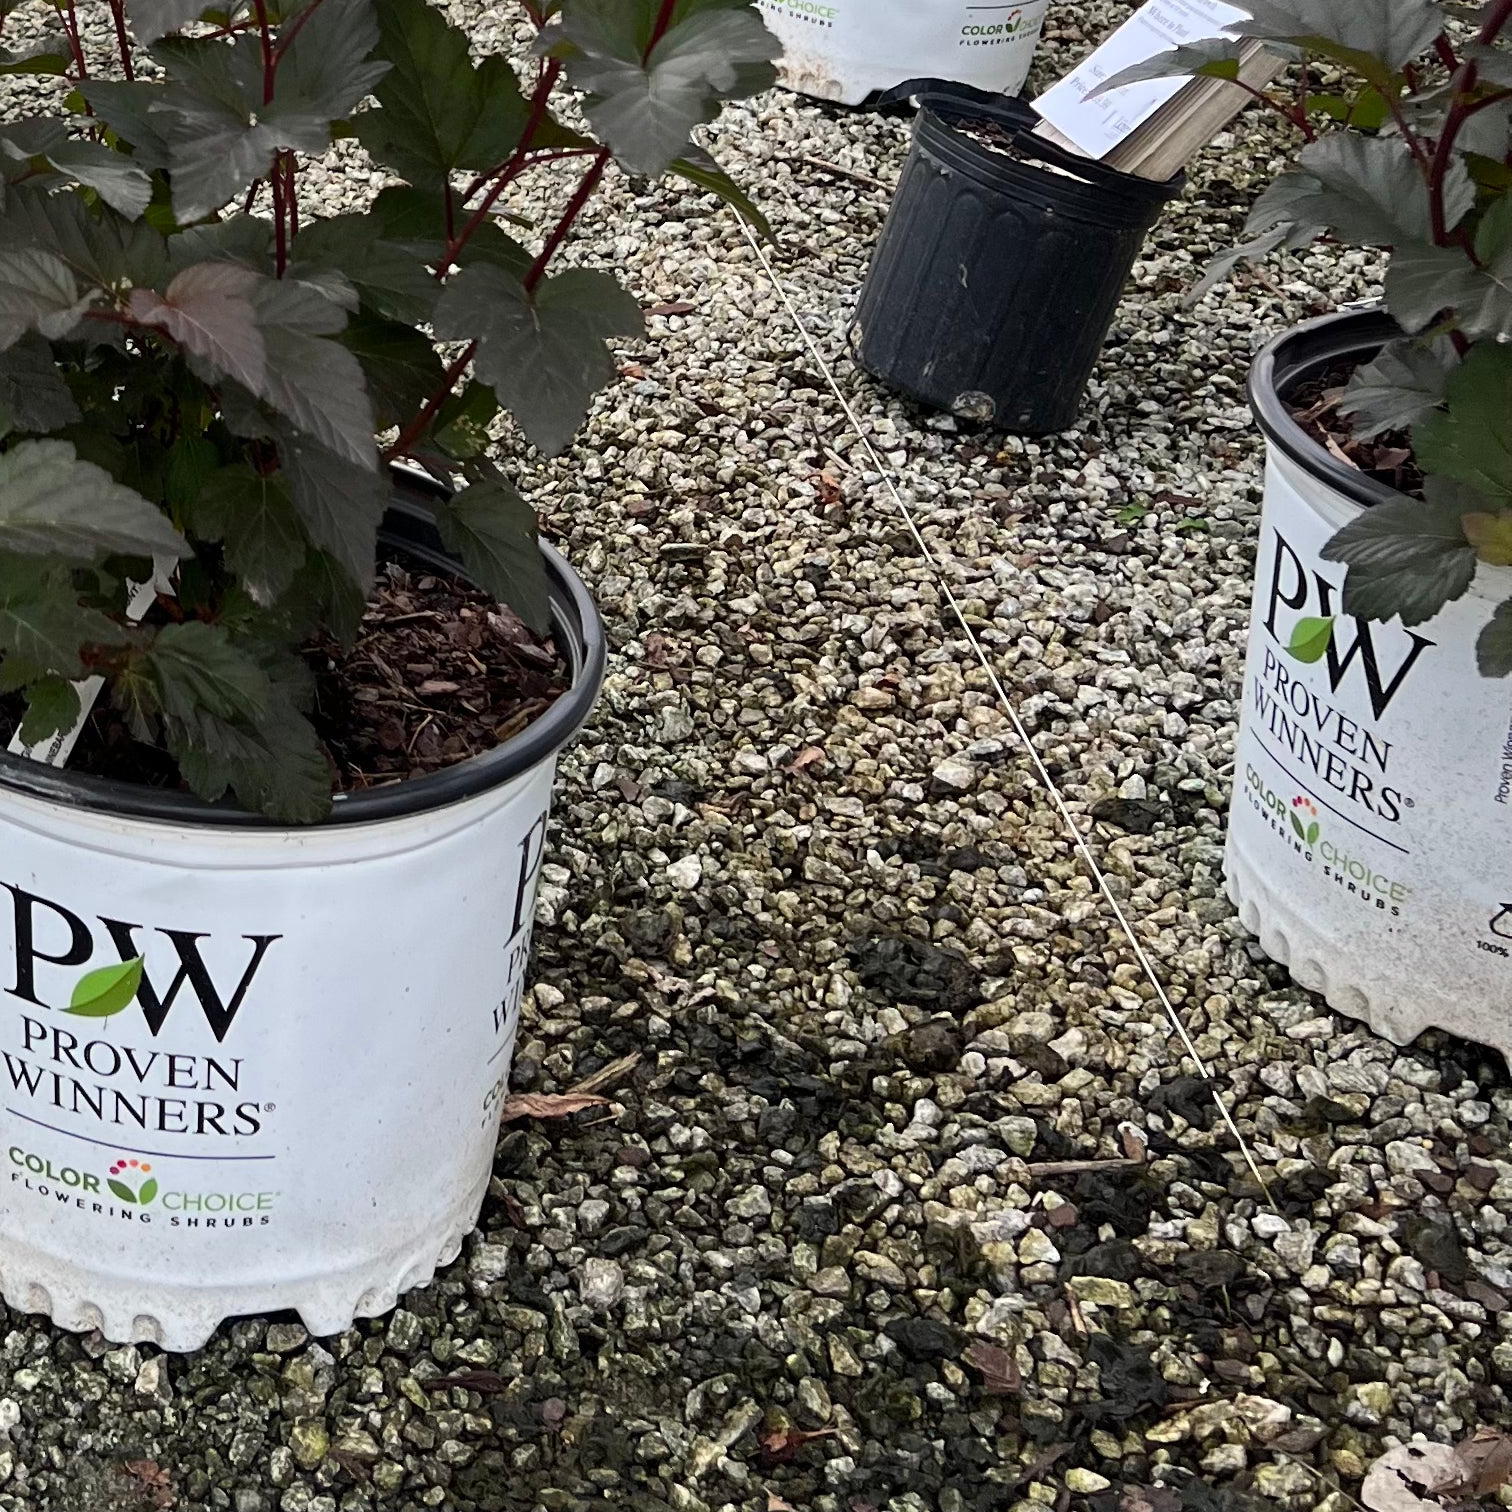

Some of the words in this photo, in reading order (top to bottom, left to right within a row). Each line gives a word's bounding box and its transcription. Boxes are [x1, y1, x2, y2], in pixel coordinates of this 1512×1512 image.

[961, 23, 1004, 36] COLOR
[1263, 526, 1437, 722] PW
[1264, 645, 1393, 773] PROVEN
[1244, 786, 1313, 862] FLOWERING
[1324, 866, 1400, 916] SHRUBS
[1246, 763, 1287, 821] COLOR
[1320, 841, 1408, 902] CHOICE
[0, 881, 283, 1043] PW
[1476, 939, 1510, 959] 100%
[20, 1014, 244, 1092] PROVEN
[9, 1146, 101, 1194] COLOR
[162, 1191, 278, 1212] CHOICE
[11, 1172, 151, 1225] FLOWERING
[171, 1215, 270, 1228] SHRUBS
